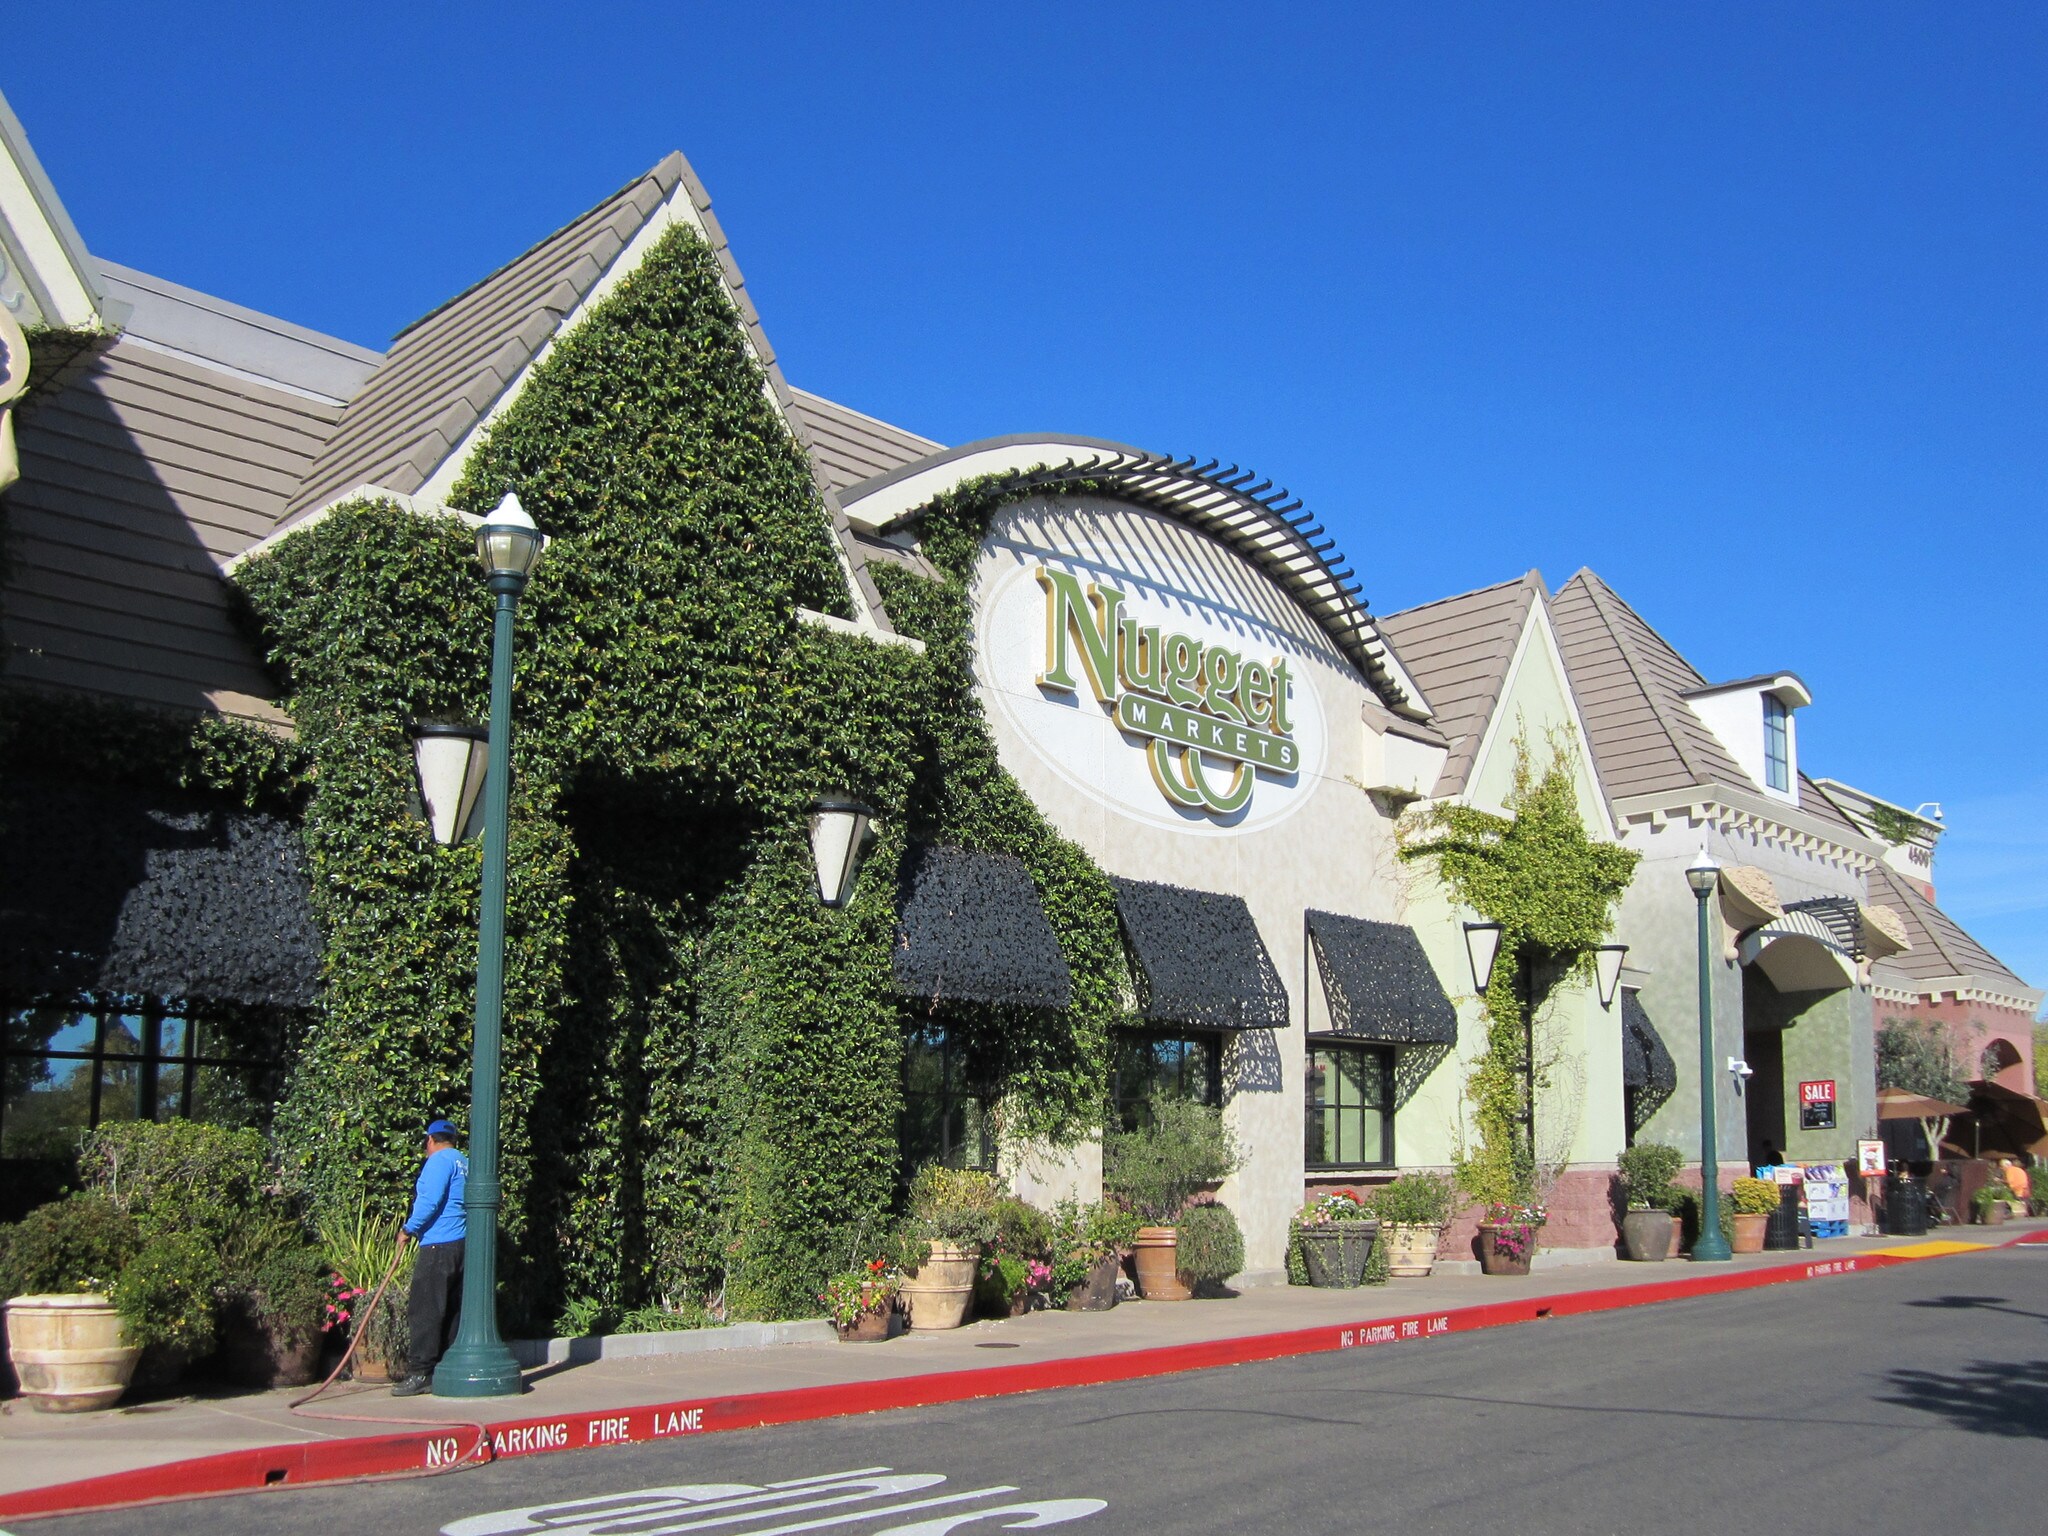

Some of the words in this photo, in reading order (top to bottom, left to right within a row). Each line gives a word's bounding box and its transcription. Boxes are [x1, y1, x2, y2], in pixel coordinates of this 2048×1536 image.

[1035, 565, 1295, 736] Nugget
[1132, 702, 1292, 765] MARKETS
[1805, 1084, 1831, 1100] SALE
[1341, 1330, 1353, 1347] NO
[1360, 1325, 1395, 1343] PARKING
[1402, 1321, 1419, 1336] FIRE
[1427, 1317, 1448, 1332] LANE
[426, 1437, 459, 1467] NO
[588, 1416, 632, 1443] FIRE
[654, 1408, 704, 1435] LANE
